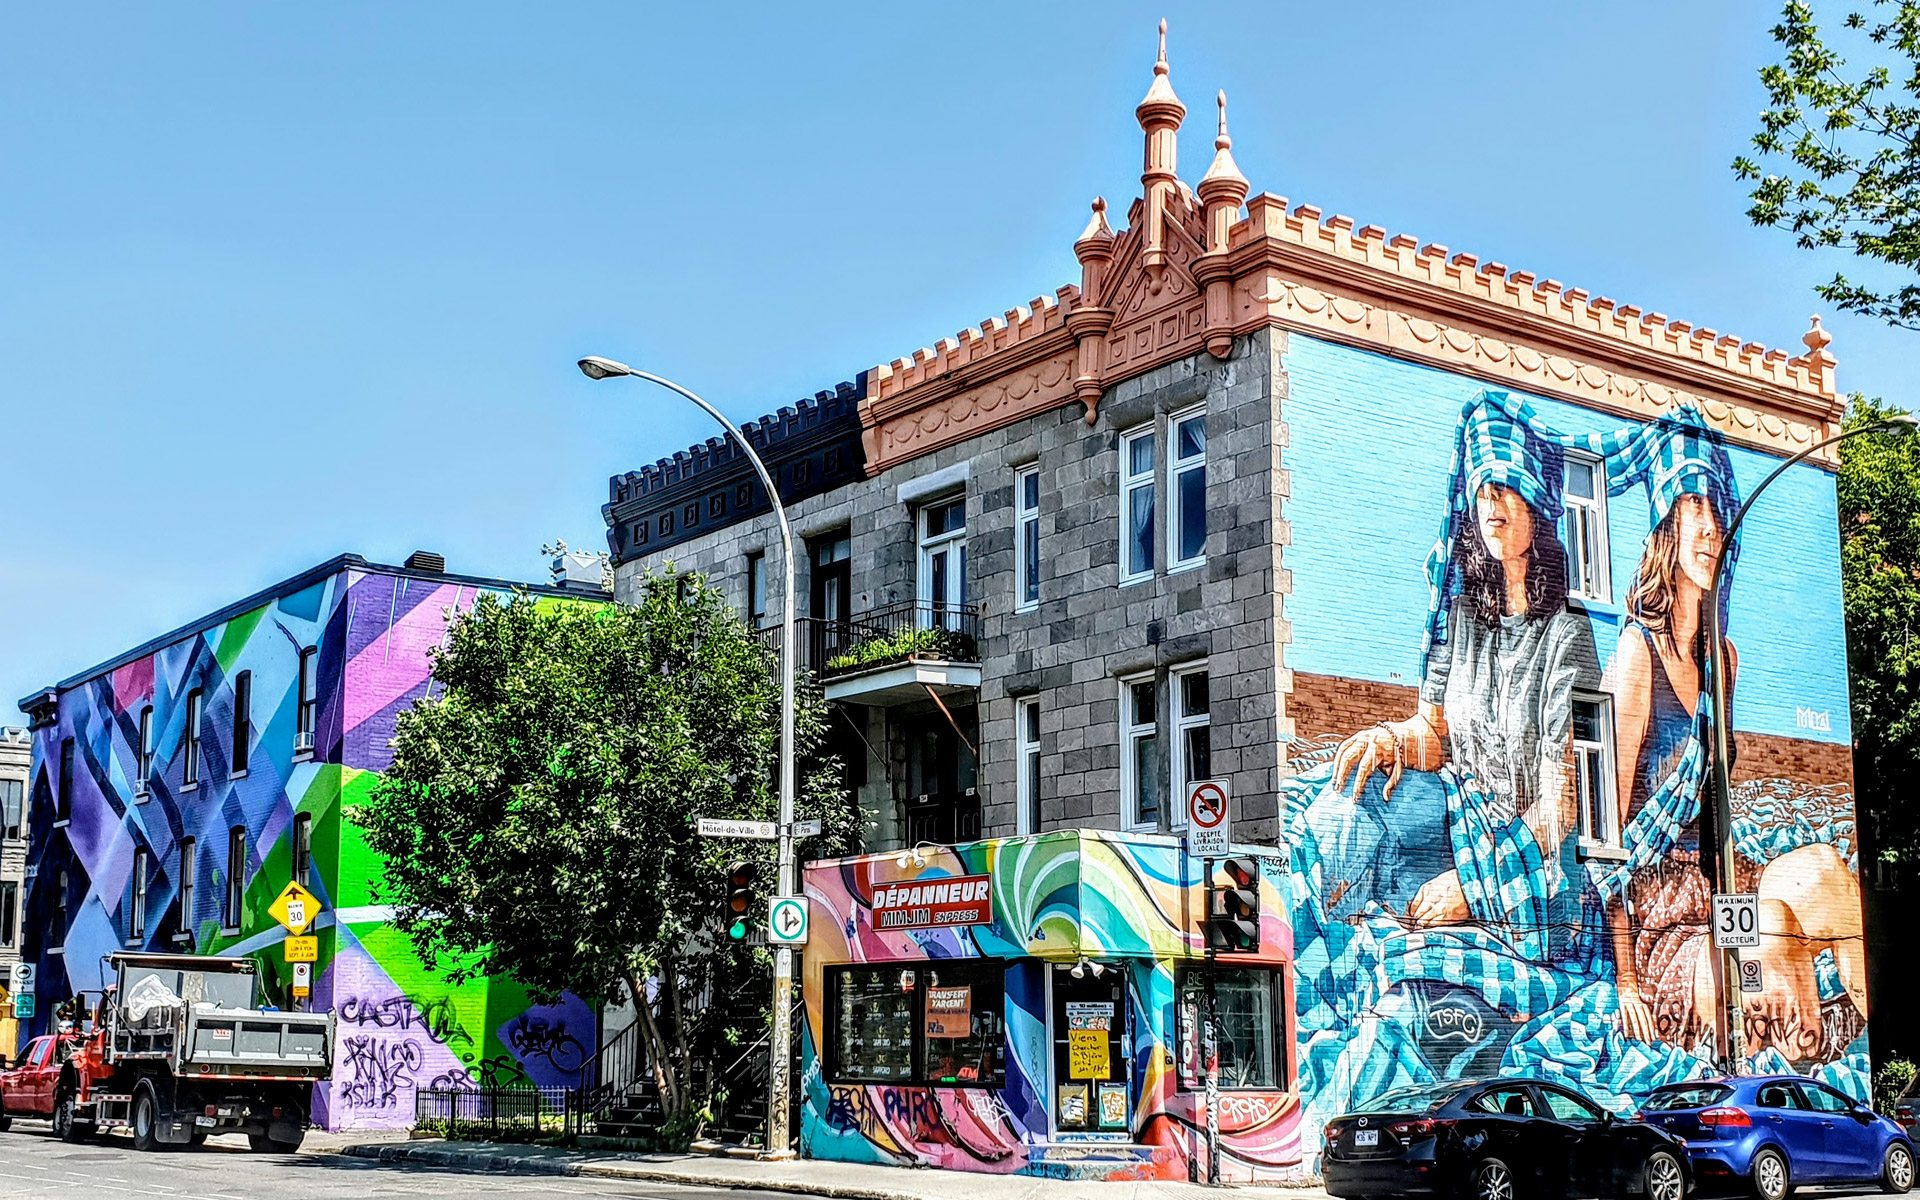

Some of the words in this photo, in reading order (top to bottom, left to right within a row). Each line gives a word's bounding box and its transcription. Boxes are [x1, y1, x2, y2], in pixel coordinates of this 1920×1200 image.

[702, 825, 755, 835] Hôtel-de-Ville
[1193, 837, 1224, 845] LIVRAISON
[873, 881, 989, 909] DÉPANNEUR
[1717, 897, 1754, 905] MAXIMUM
[290, 911, 303, 922] 30
[881, 908, 931, 927] MIMJIM
[934, 909, 979, 923] EXPRESS
[1720, 907, 1754, 933] 30
[1720, 936, 1755, 944] SECTEUR
[1070, 1032, 1098, 1043] Viens
[957, 1066, 979, 1080] ATM
